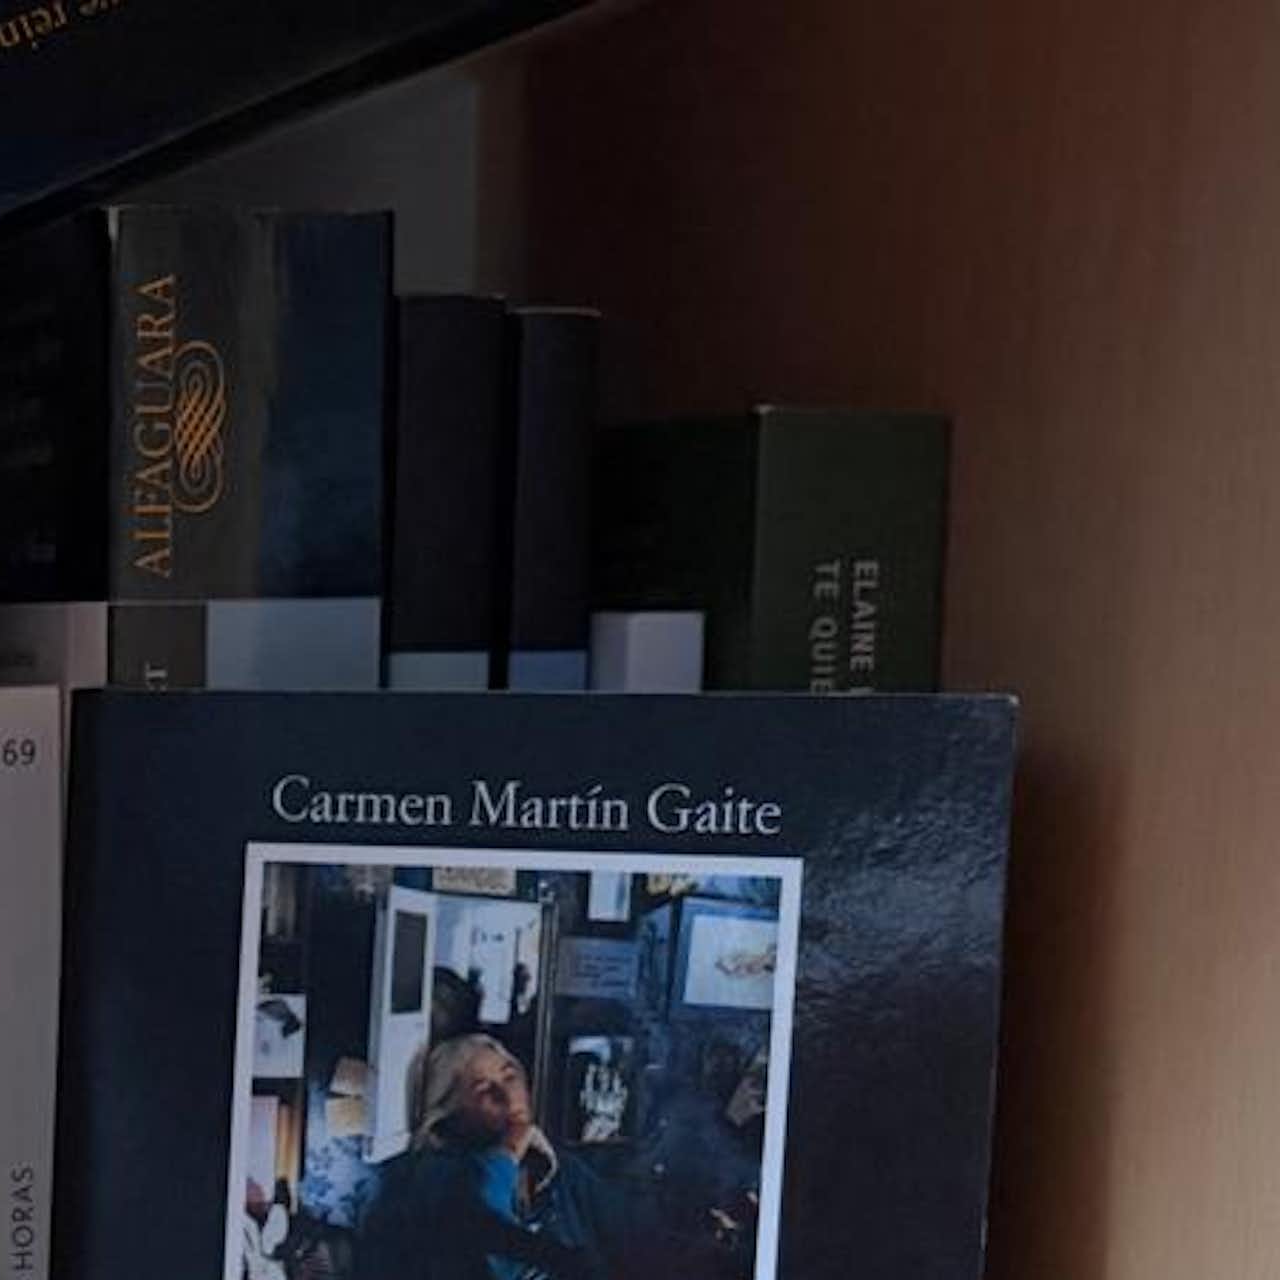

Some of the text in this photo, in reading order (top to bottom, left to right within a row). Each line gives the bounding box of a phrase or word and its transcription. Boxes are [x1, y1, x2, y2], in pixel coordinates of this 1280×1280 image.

[131, 272, 176, 578] ALFAGUARA
[814, 557, 840, 600] TE
[850, 559, 880, 672] ELAINE
[2, 738, 36, 767] 69
[271, 774, 783, 837] Carmen Martín Gaite
[10, 1166, 35, 1271] HORAS
